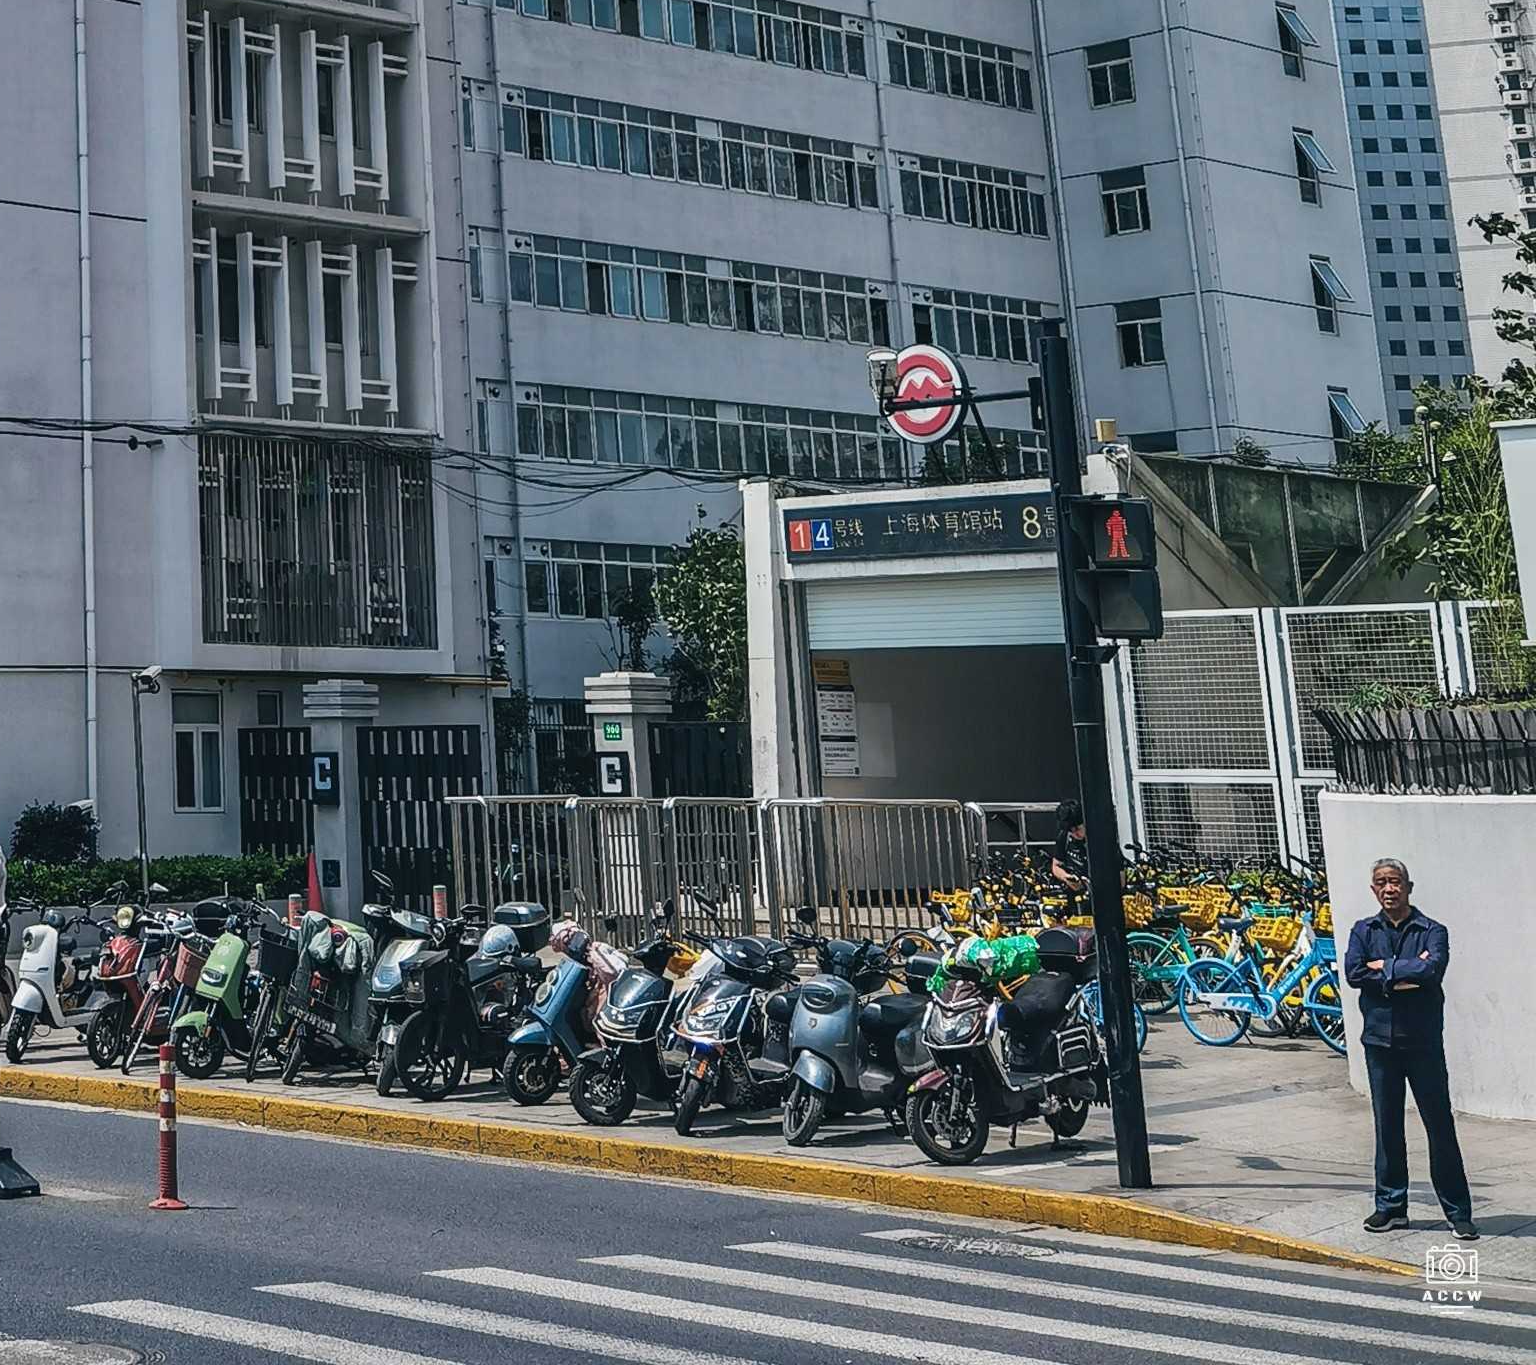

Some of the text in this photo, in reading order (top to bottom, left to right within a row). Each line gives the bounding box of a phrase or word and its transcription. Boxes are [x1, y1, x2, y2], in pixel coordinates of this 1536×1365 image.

[882, 507, 1003, 536] 上海体育馆站
